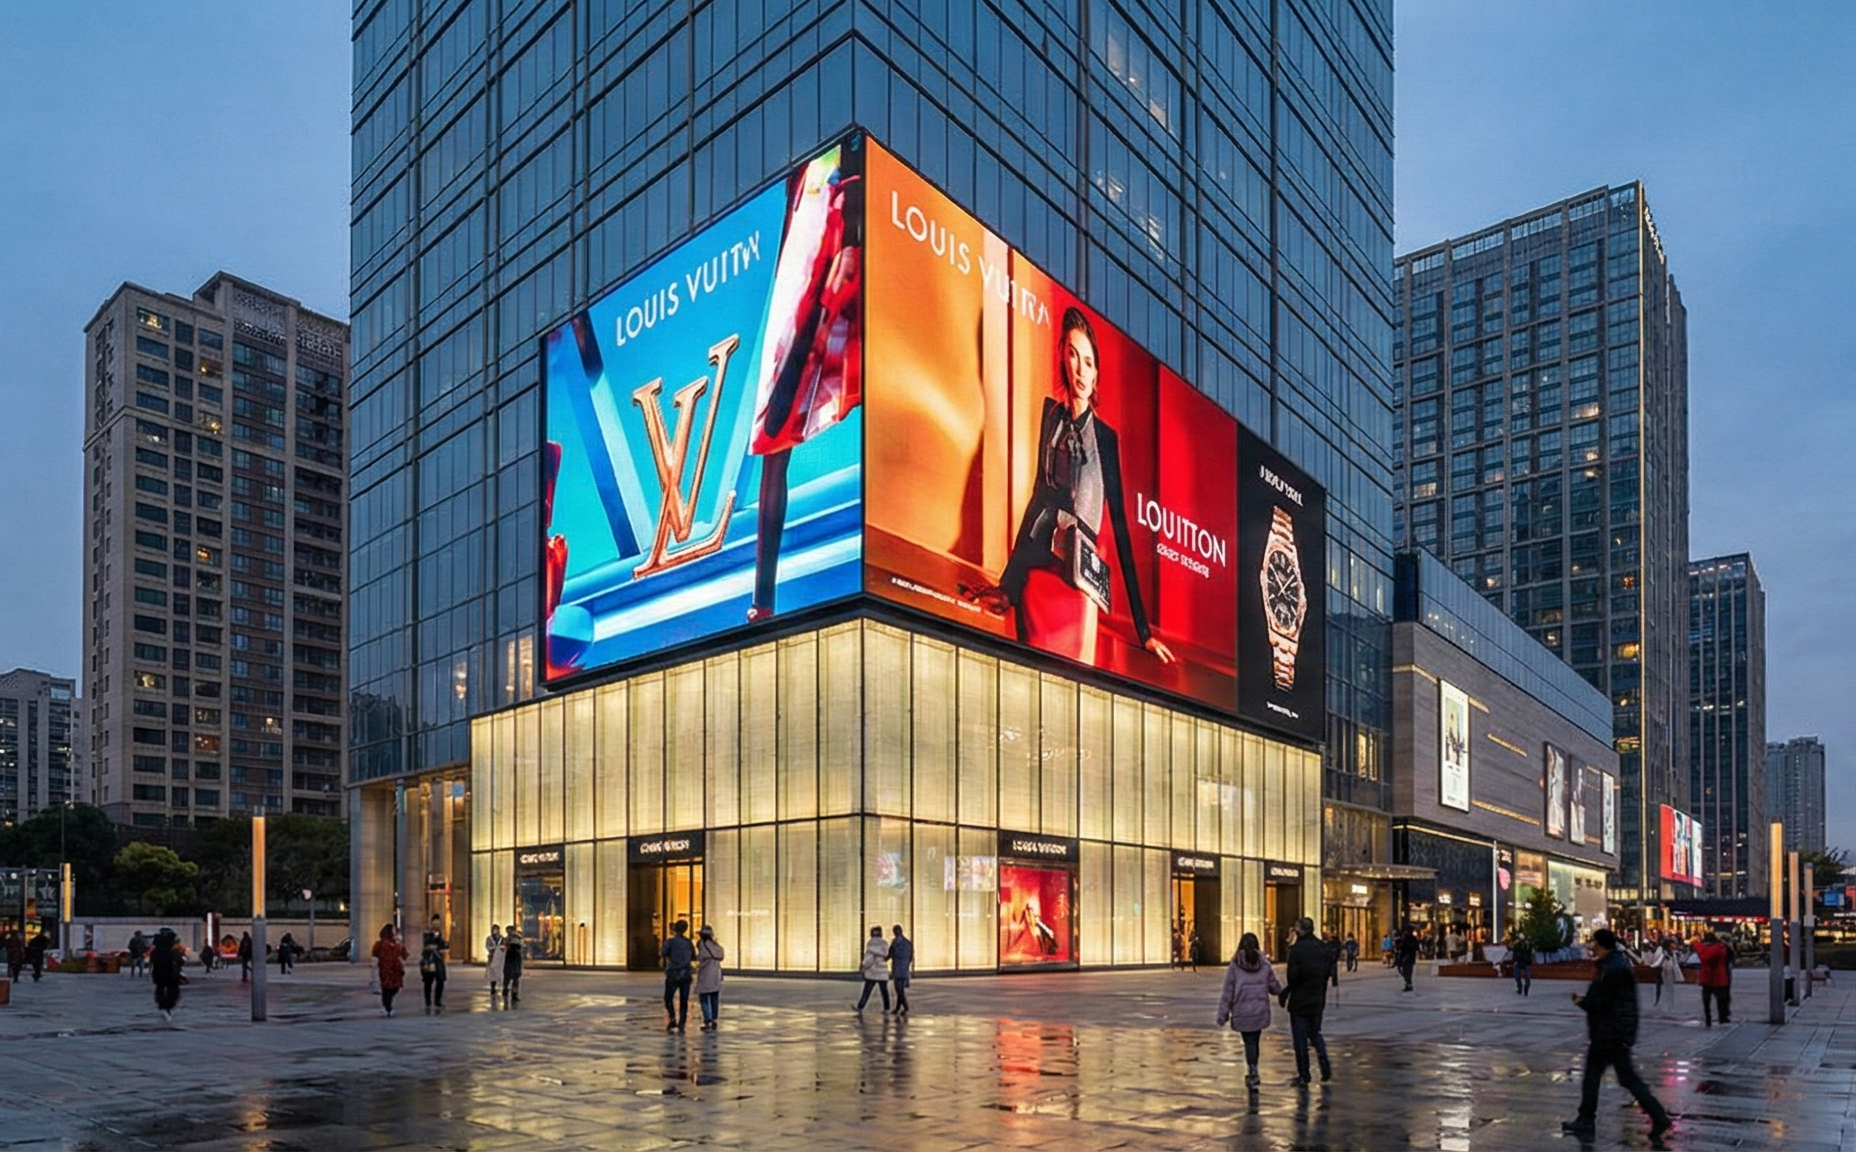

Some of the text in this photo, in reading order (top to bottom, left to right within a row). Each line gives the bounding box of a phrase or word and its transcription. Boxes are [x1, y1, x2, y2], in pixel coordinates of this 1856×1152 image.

[891, 190, 970, 275] LOUIS
[616, 282, 679, 347] LOUIS
[1137, 492, 1226, 568] LOUITTON
